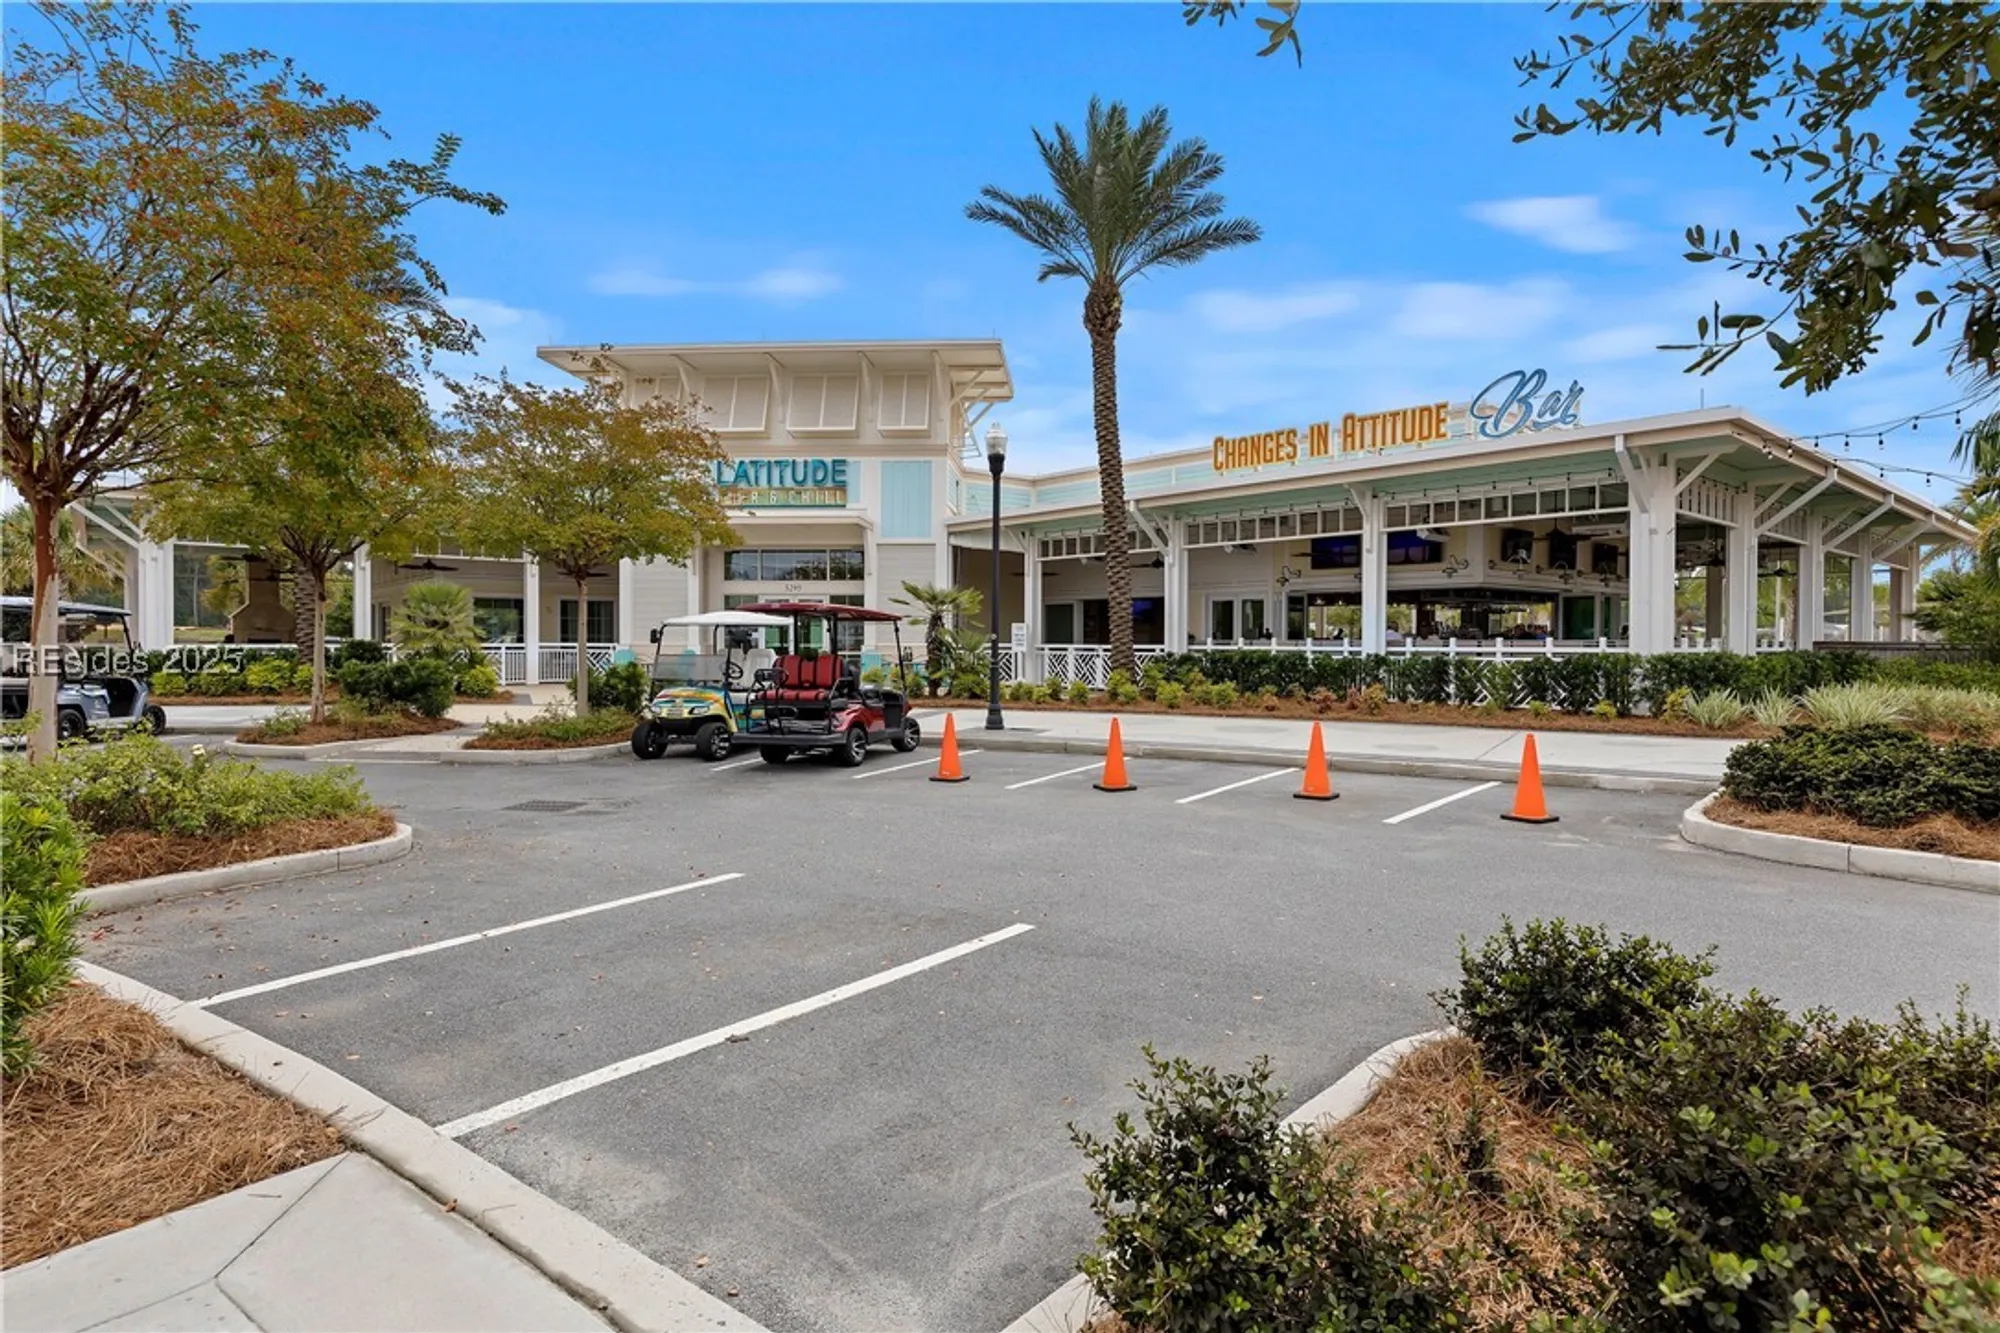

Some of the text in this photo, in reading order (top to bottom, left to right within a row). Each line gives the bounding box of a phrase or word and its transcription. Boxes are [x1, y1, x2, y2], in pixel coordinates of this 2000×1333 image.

[1212, 426, 1299, 472] CHANGES
[1341, 401, 1450, 453] ATTITUDE
[1469, 368, 1584, 438] Bar
[716, 459, 847, 487] LATITUDE
[788, 490, 842, 505] CHILL
